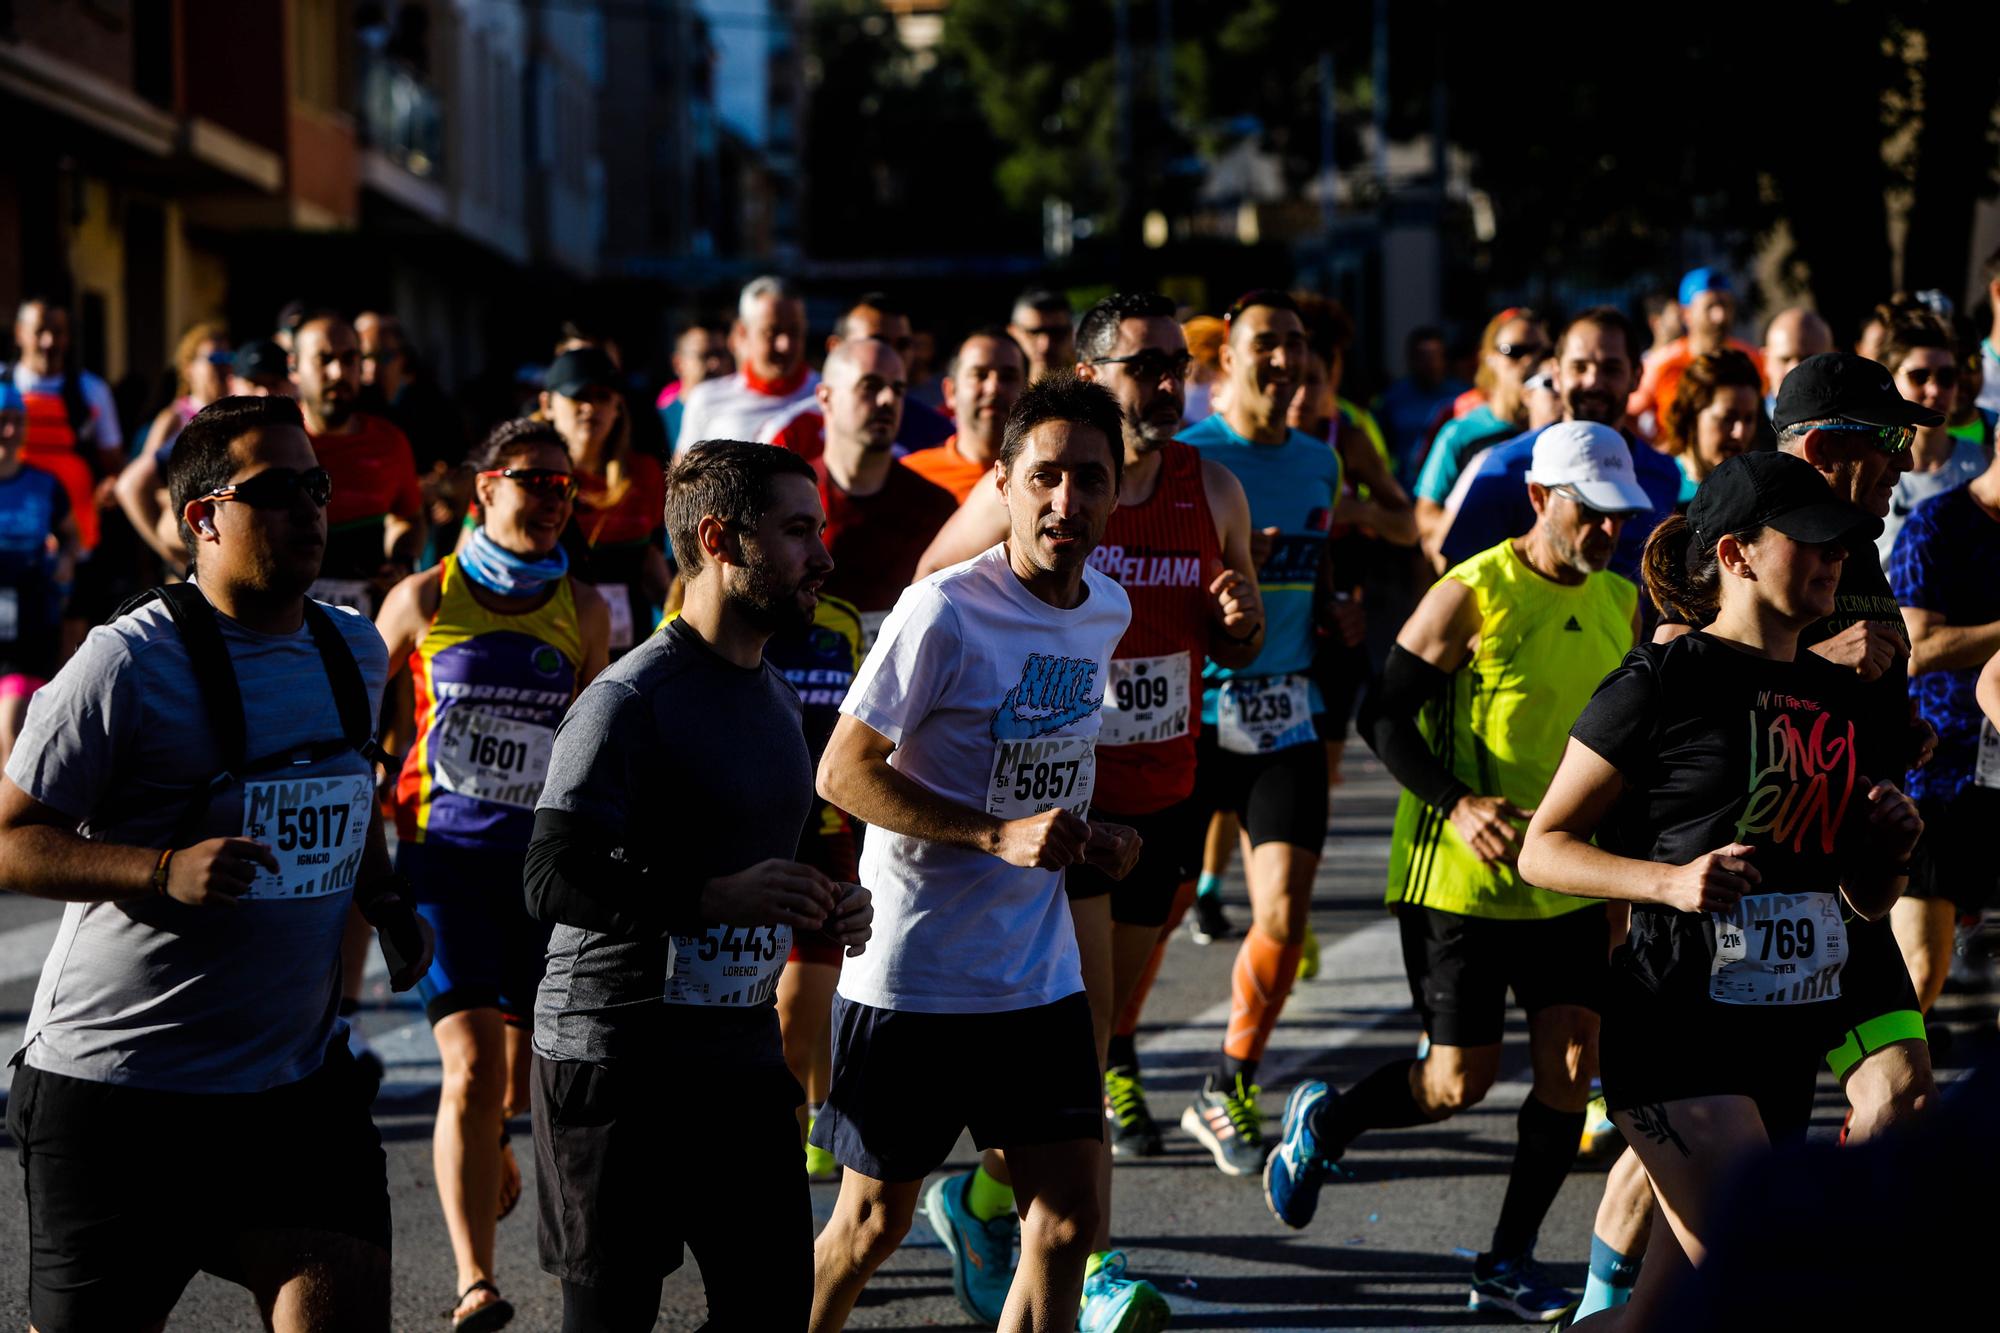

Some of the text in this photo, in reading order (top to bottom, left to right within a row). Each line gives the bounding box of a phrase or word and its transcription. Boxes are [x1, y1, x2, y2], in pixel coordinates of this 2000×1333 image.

[1015, 652, 1098, 709] NIKE
[1116, 676, 1167, 711] 909
[1756, 689, 1771, 711] IN
[1773, 693, 1785, 709] IT
[1237, 692, 1293, 723] 1239
[469, 733, 528, 772] 1601
[1748, 709, 1847, 793] LONG
[1014, 760, 1080, 801] 5857
[277, 803, 350, 851] 5917
[297, 853, 330, 866] IGNACIO
[697, 923, 777, 962] 5443
[1755, 917, 1815, 961] 769
[722, 966, 758, 977] LORENZO
